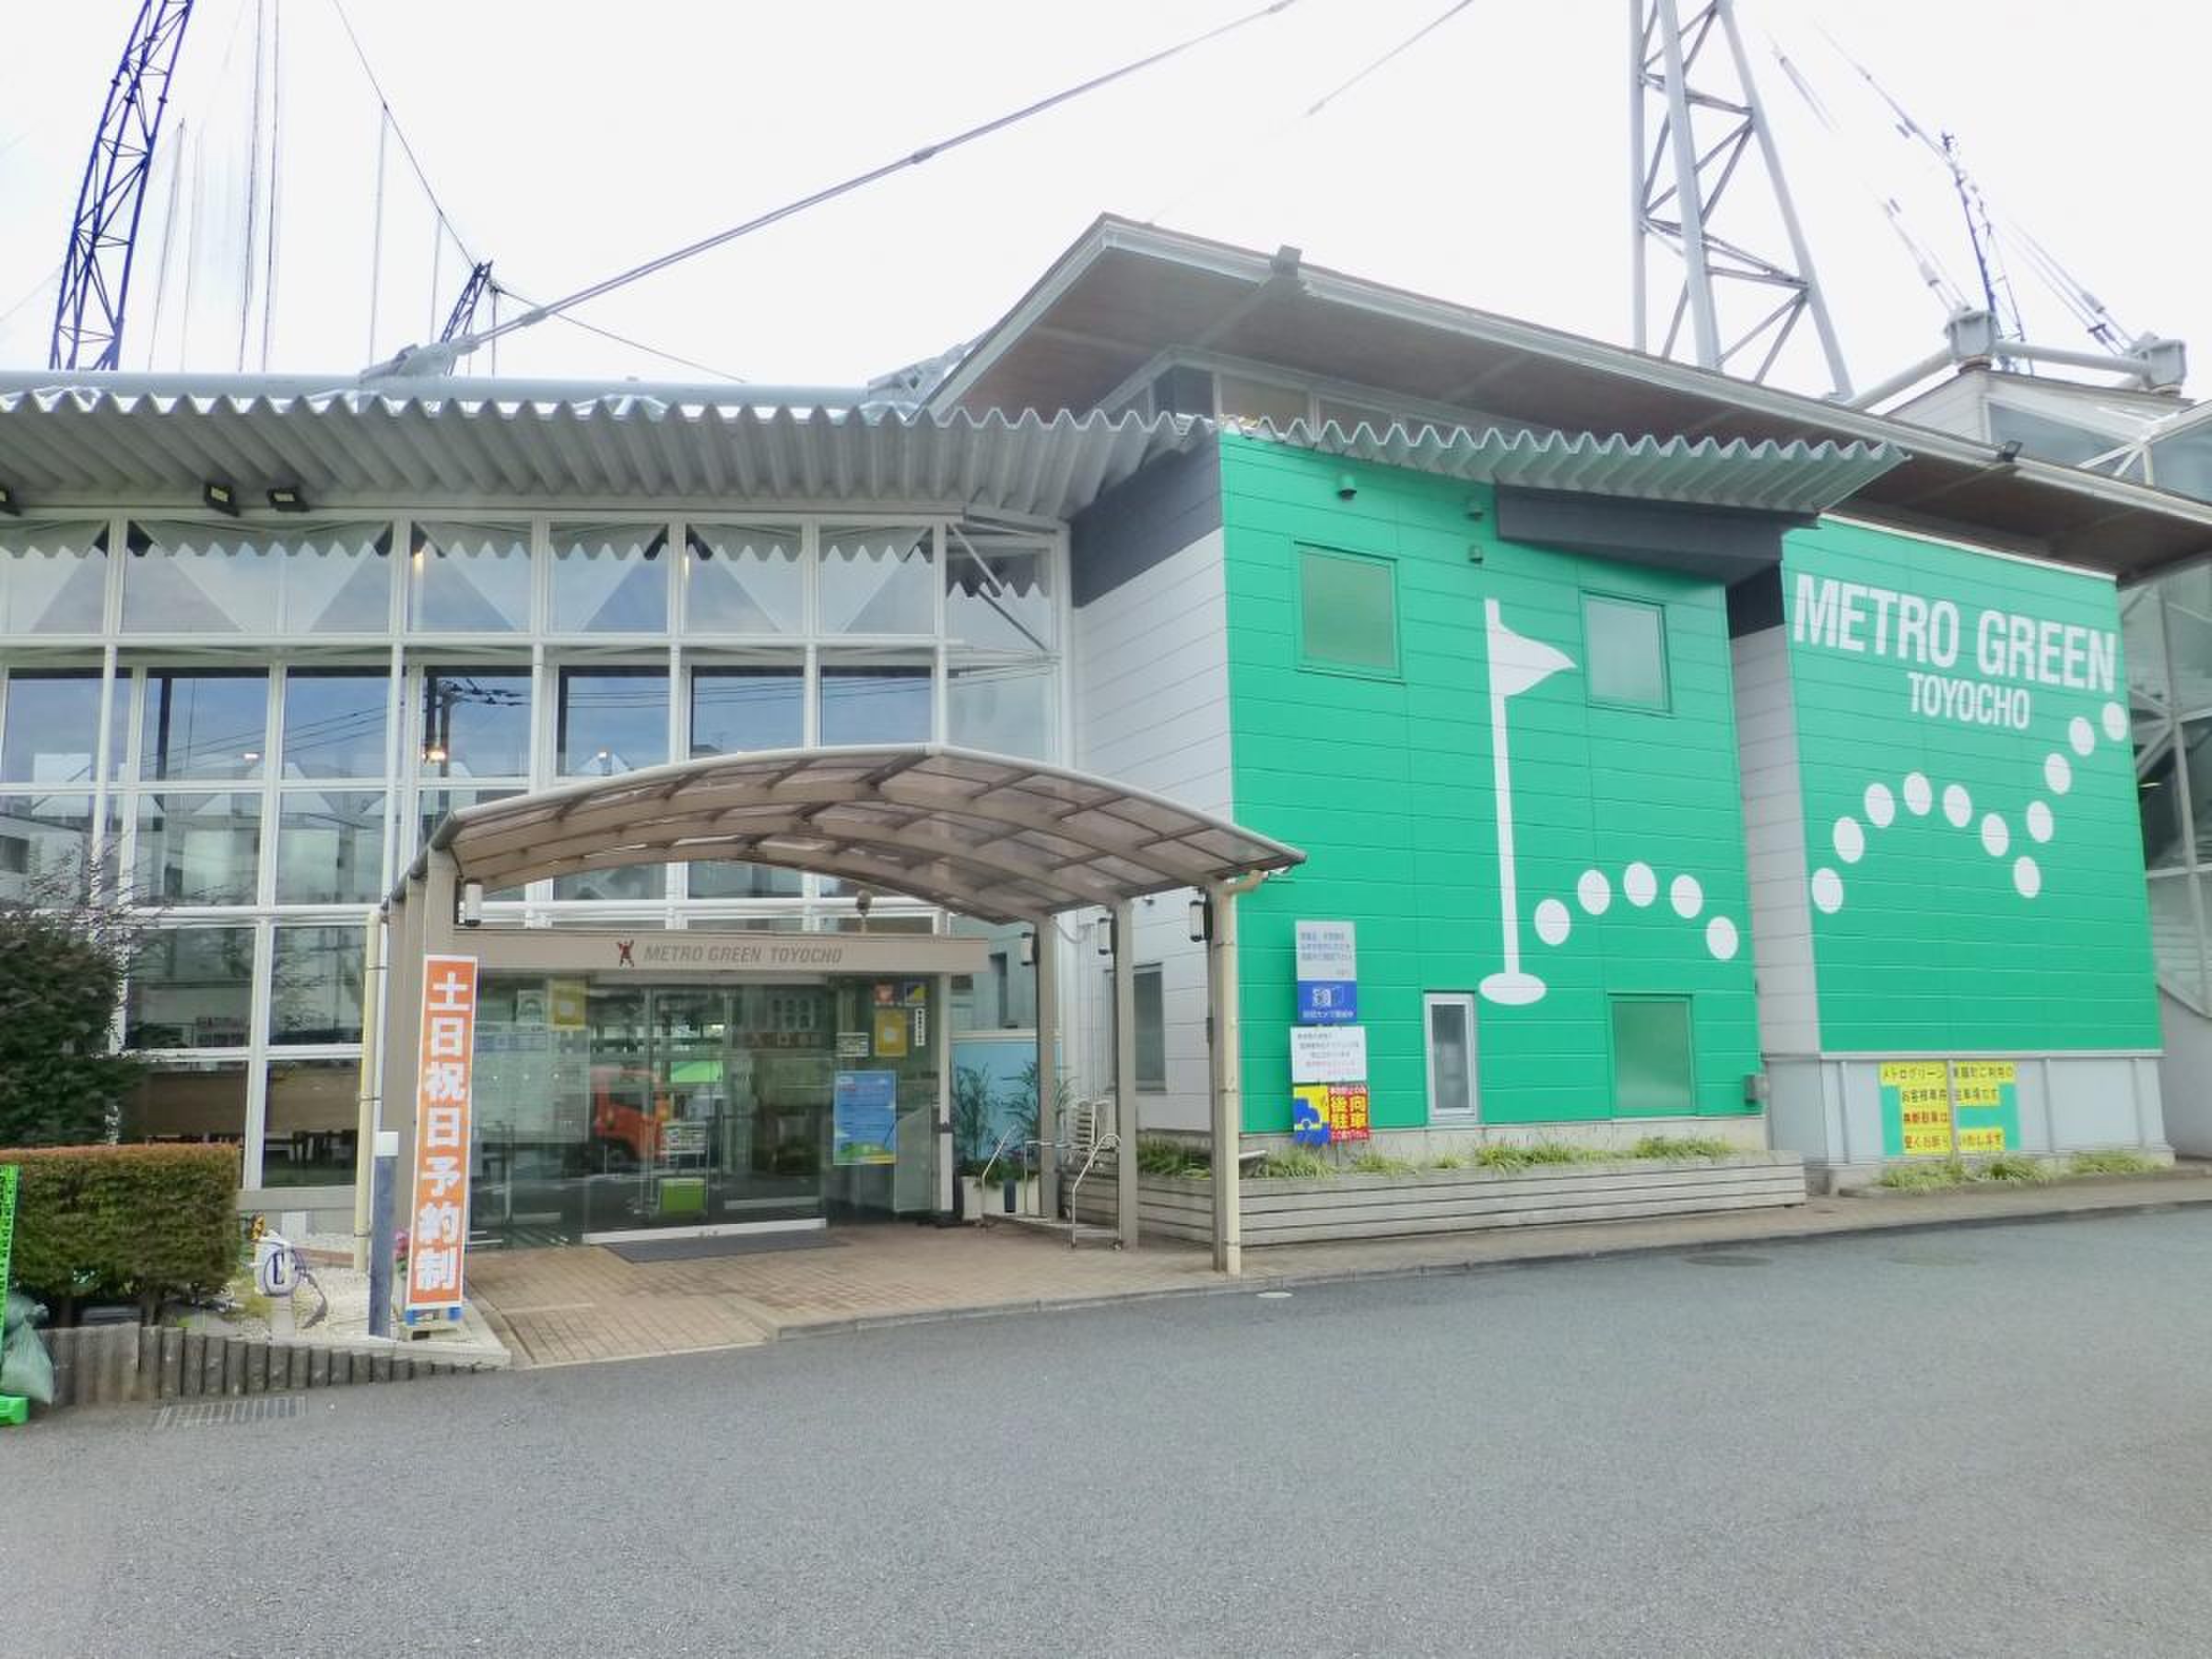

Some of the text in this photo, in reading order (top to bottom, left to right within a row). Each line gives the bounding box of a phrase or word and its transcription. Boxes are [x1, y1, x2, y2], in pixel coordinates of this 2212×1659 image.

[1793, 573, 2116, 693] METRO GREEN
[1907, 672, 2030, 729] TOYOCHO
[644, 944, 842, 964] METRO GREEN TOYOCHO
[415, 971, 471, 1290] 土日祝日予約制
